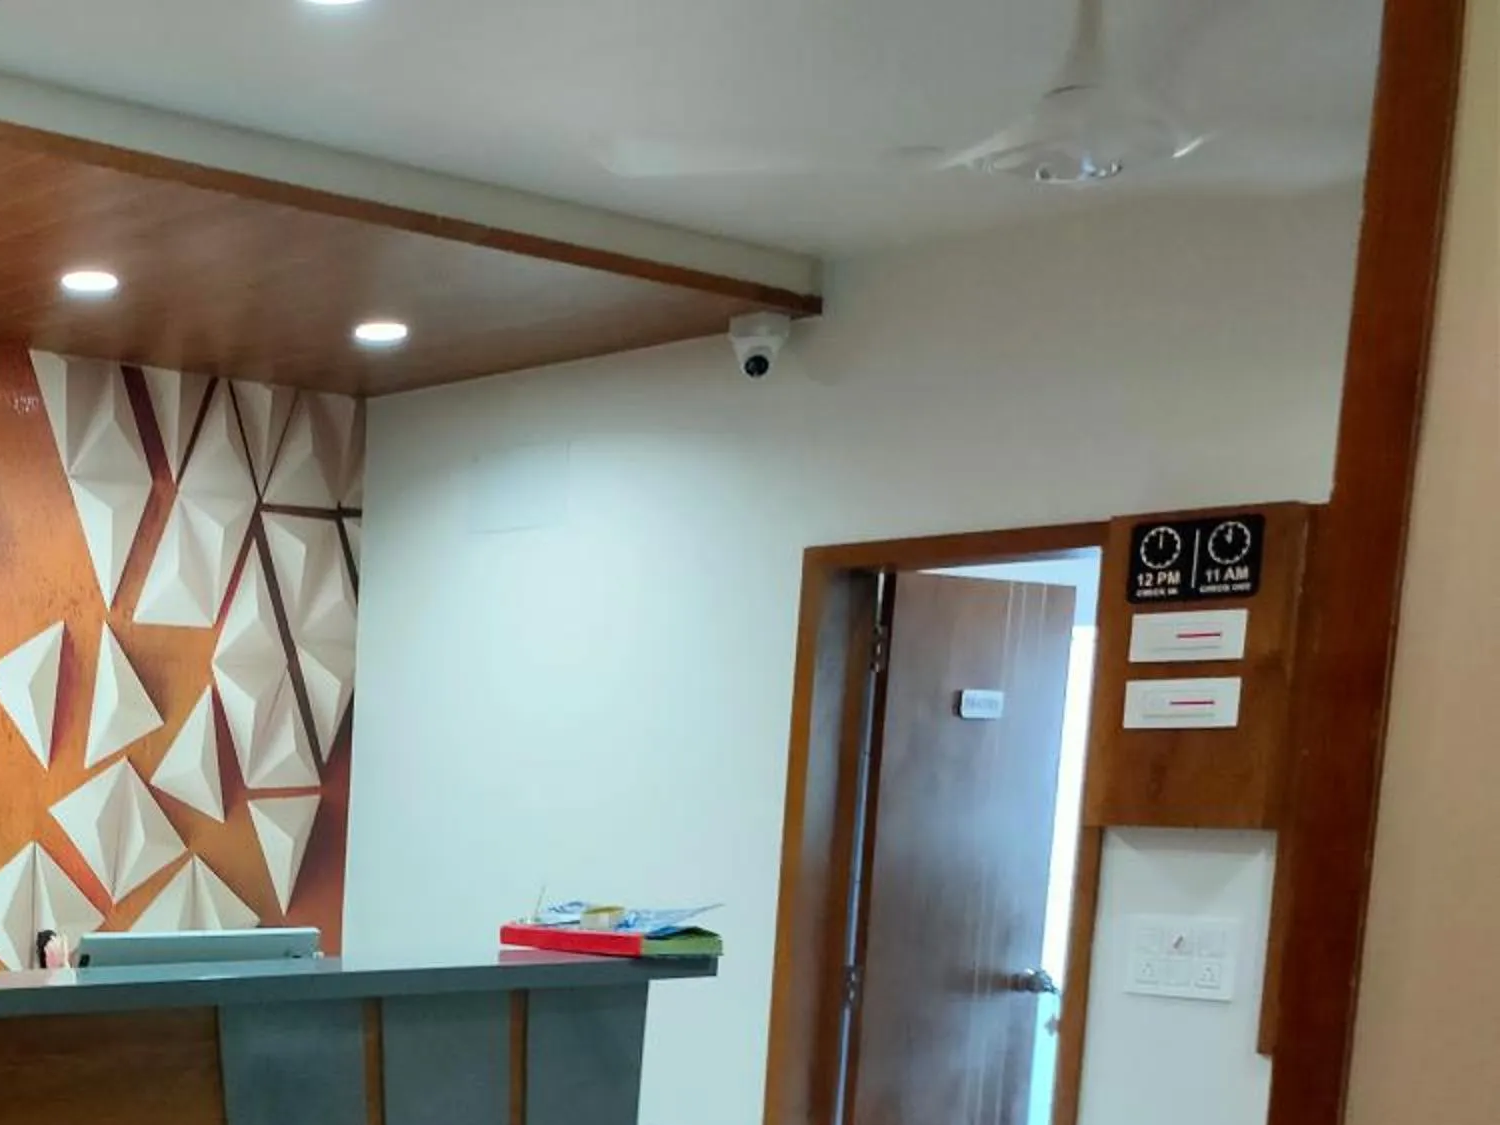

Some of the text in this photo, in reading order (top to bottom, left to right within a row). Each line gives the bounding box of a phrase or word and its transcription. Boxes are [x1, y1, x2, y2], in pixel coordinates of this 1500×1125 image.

[1137, 569, 1181, 587] 12 PM
[1205, 565, 1249, 583] 11 AM
